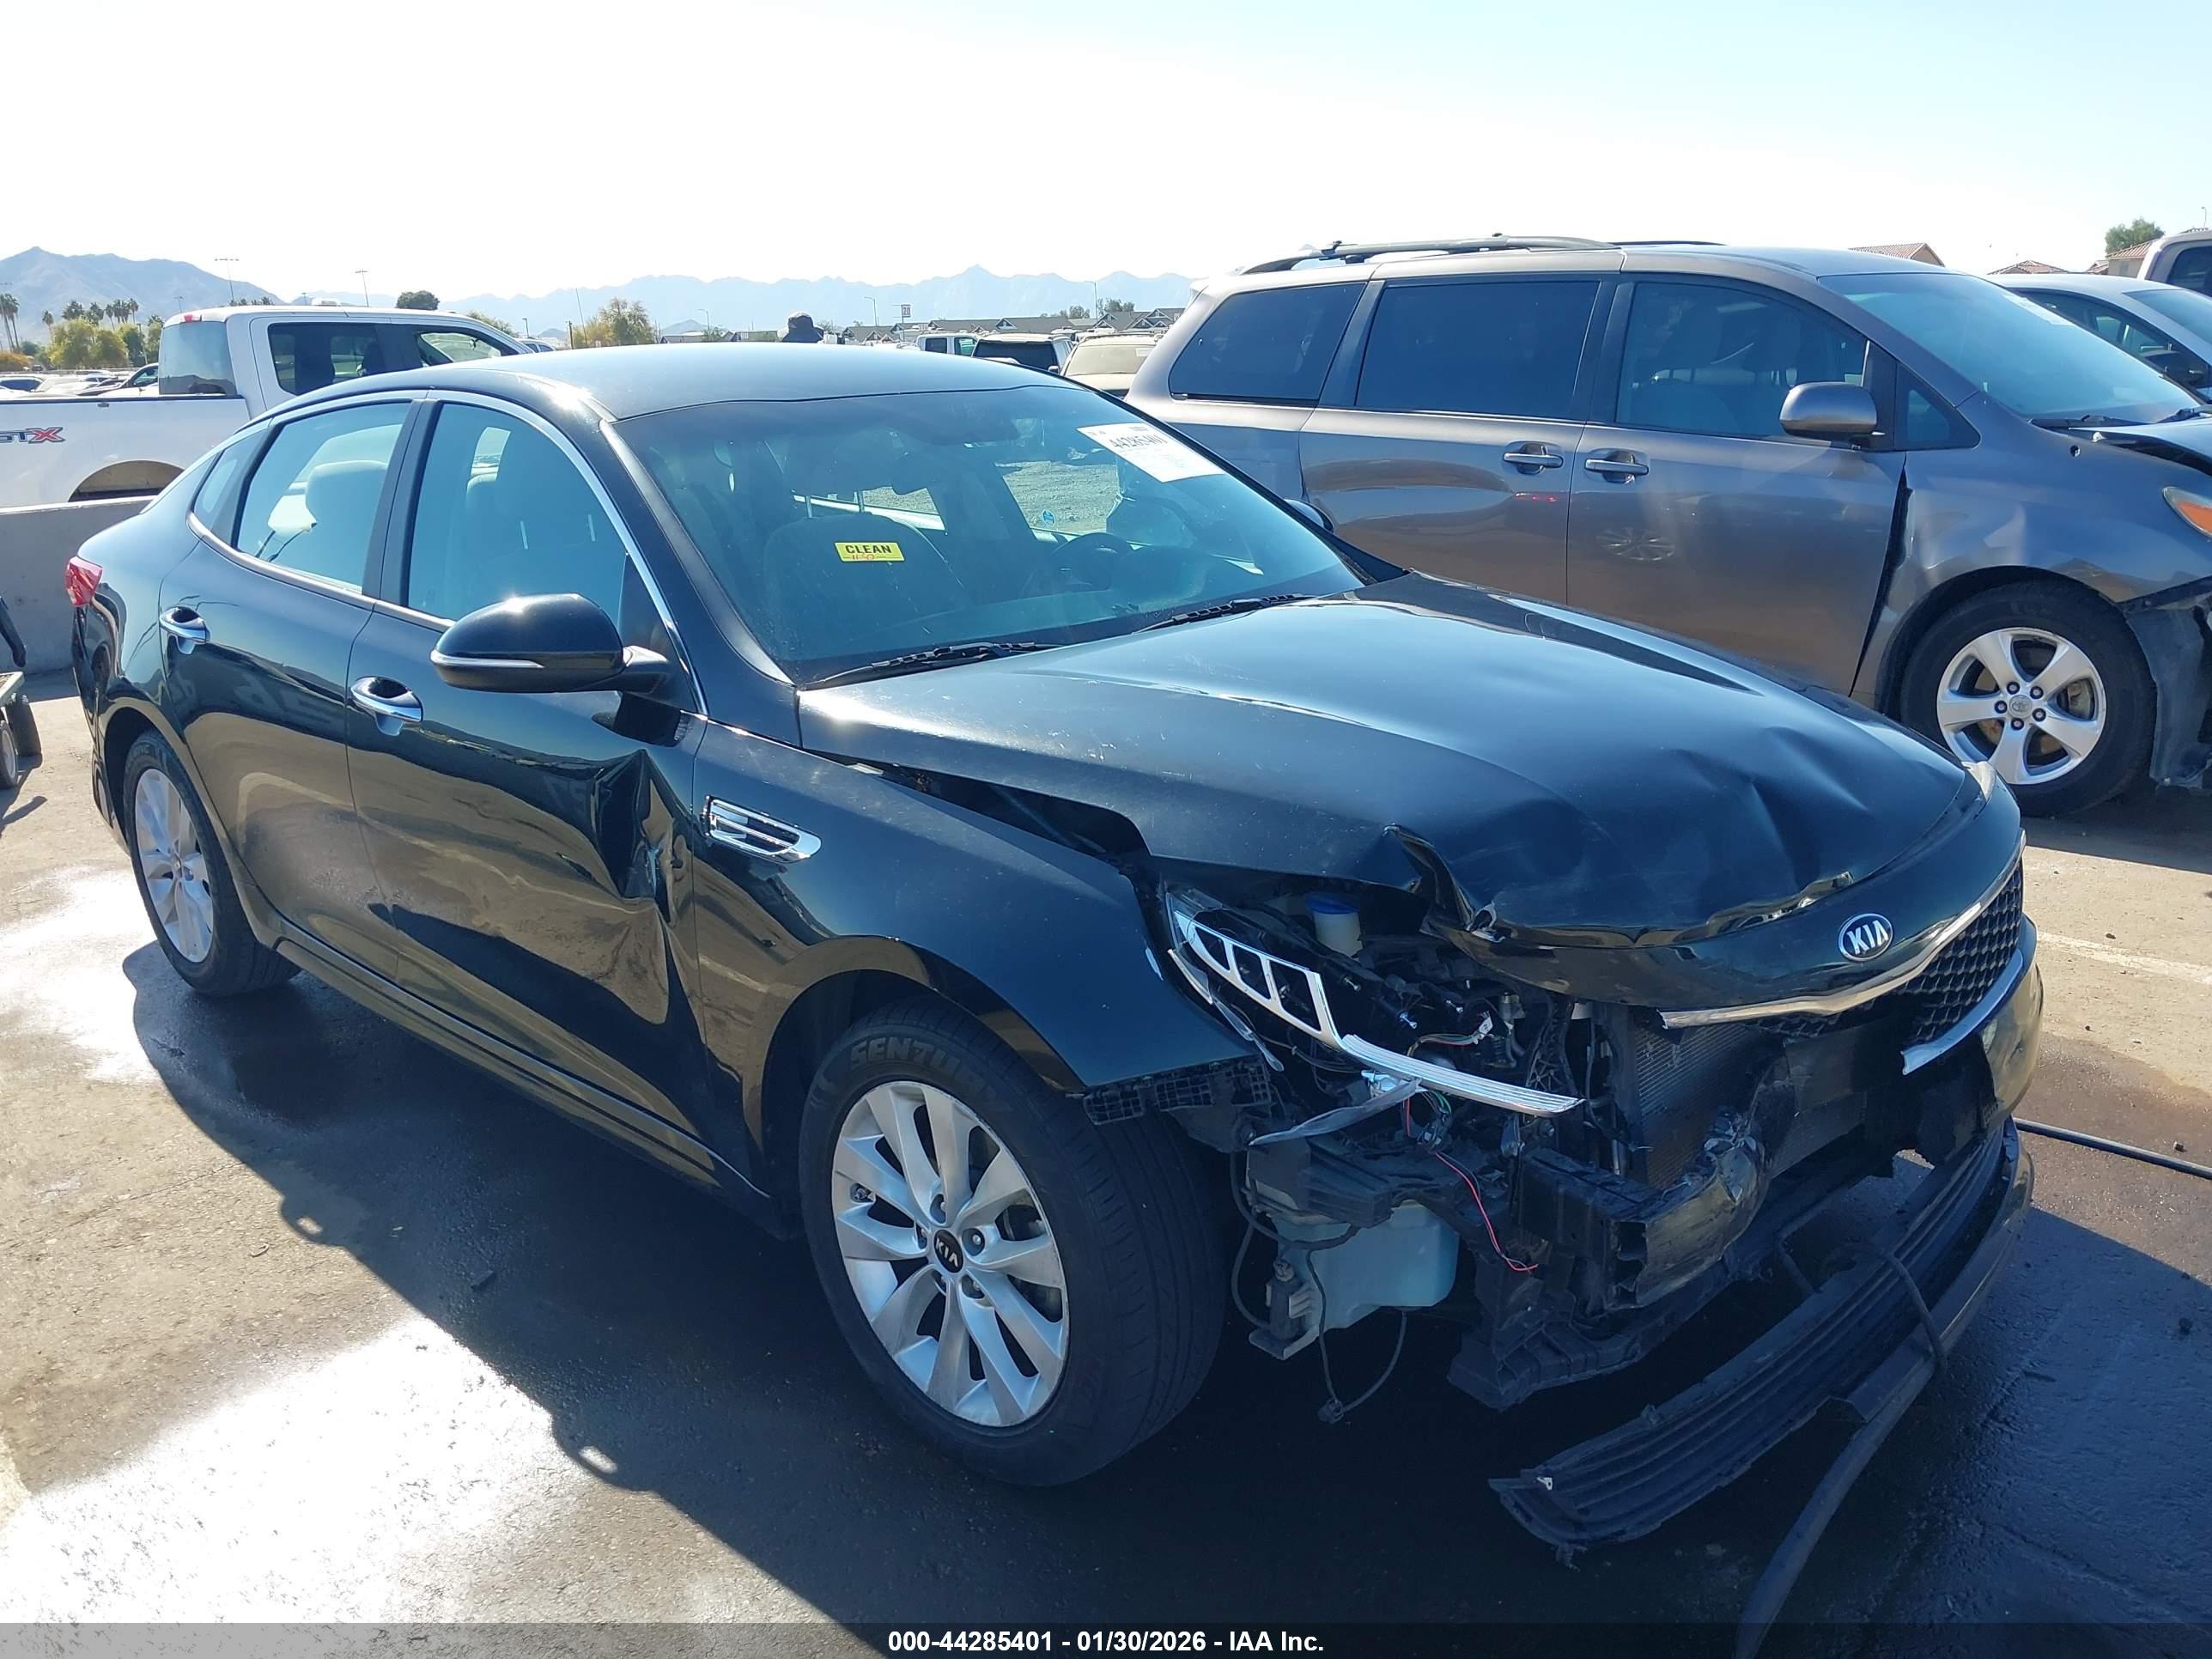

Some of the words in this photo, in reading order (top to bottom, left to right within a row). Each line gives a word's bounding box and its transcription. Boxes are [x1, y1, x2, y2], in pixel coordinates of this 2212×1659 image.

[845, 544, 893, 554] CLEAN
[1846, 920, 1889, 955] KIA
[936, 1237, 958, 1267] KIA
